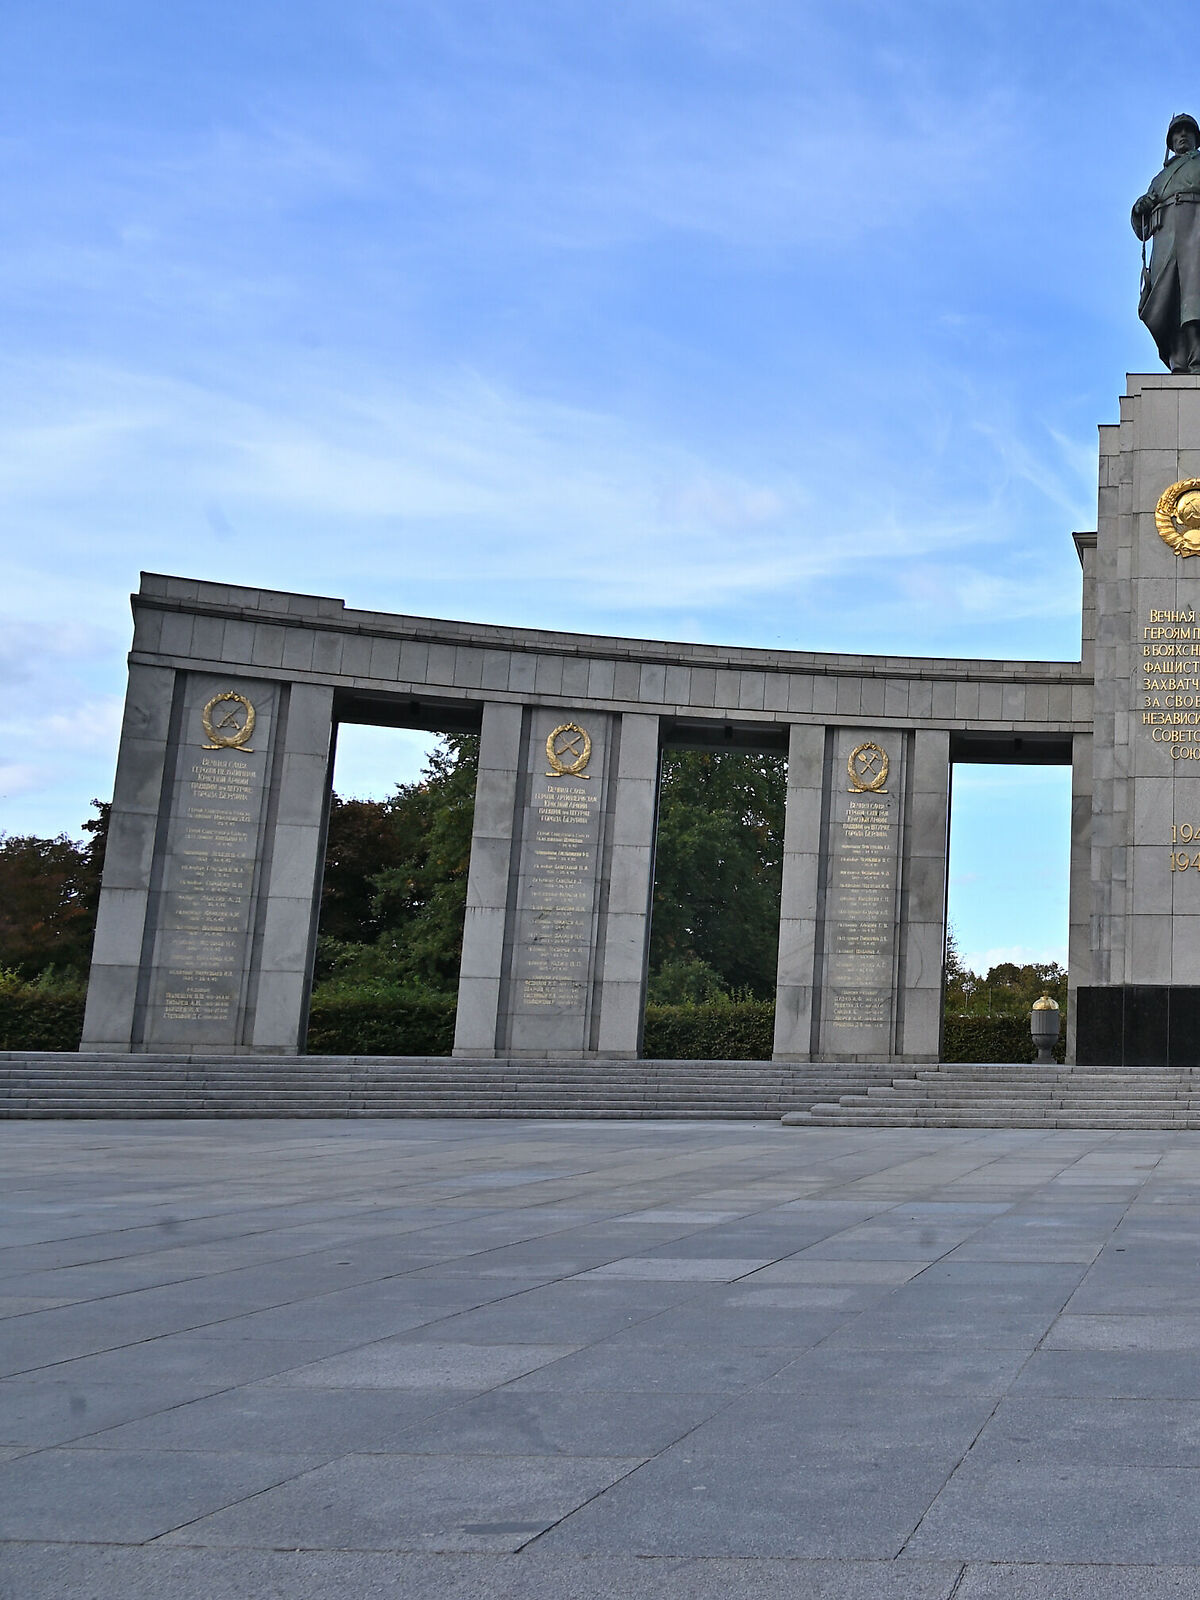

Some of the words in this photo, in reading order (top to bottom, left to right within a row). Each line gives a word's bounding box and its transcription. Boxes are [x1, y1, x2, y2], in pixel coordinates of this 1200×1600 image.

[1150, 609, 1195, 623] ВЕЧНАЯ
[1143, 627, 1191, 640] ГЕРОЯМ
[1152, 644, 1182, 656] БОЯХ
[1144, 696, 1161, 708] ЗА
